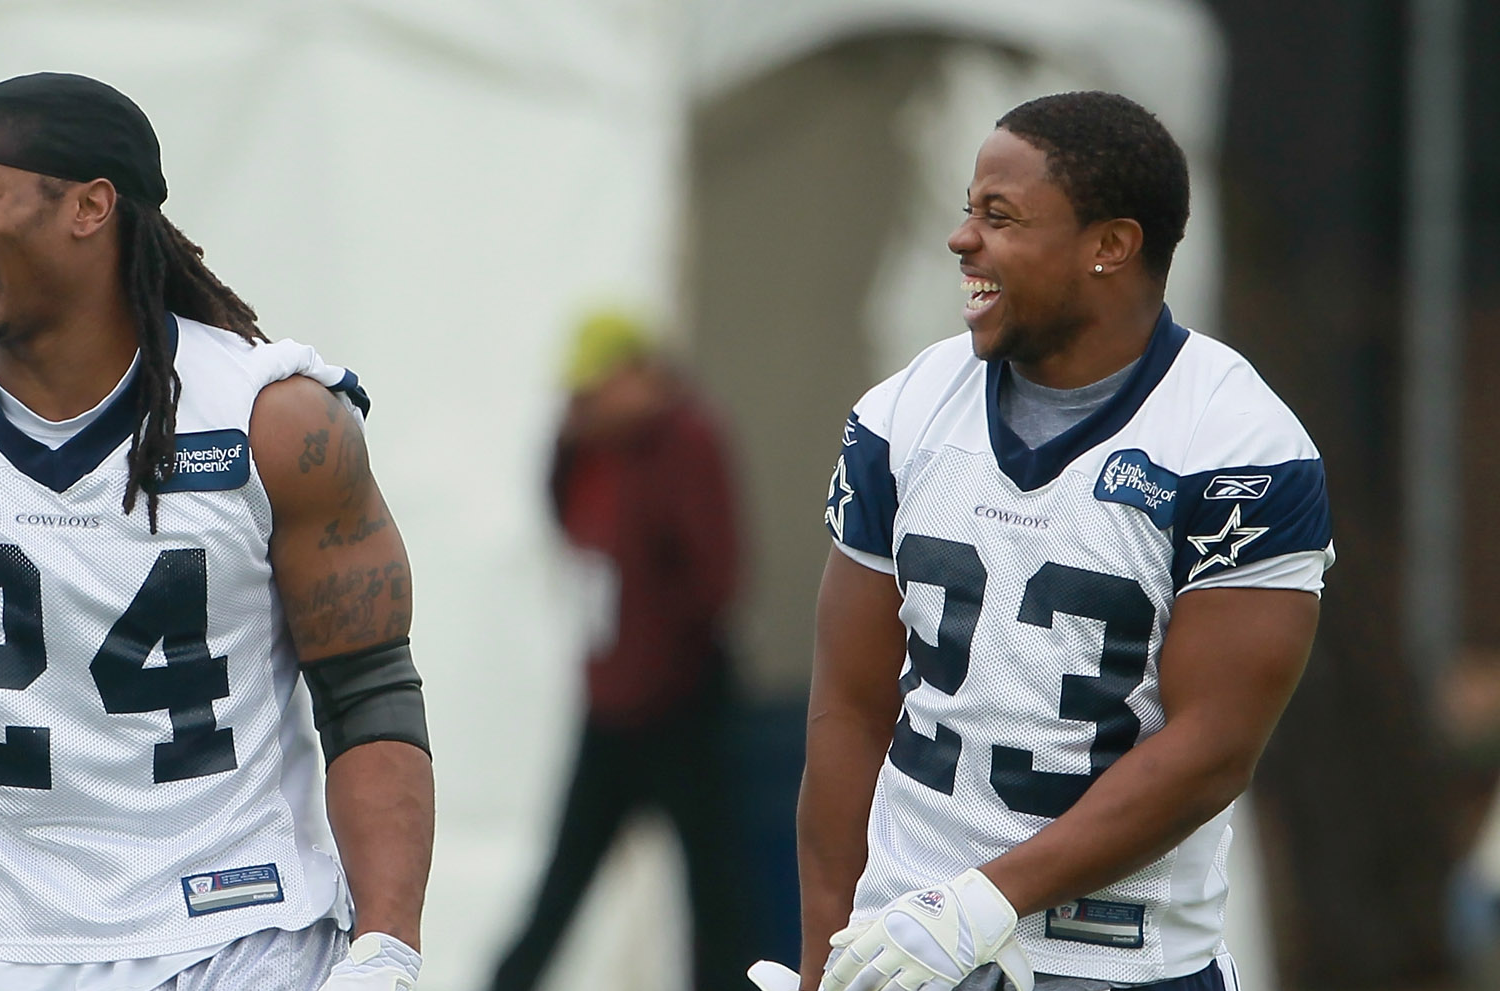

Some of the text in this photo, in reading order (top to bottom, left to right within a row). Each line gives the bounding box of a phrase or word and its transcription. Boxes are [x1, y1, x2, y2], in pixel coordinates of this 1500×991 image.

[174, 444, 242, 462] niversity of
[1161, 490, 1177, 502] of
[15, 514, 100, 528] COWBOYS
[974, 505, 1051, 529] COWBOYS
[889, 533, 1156, 818] 23
